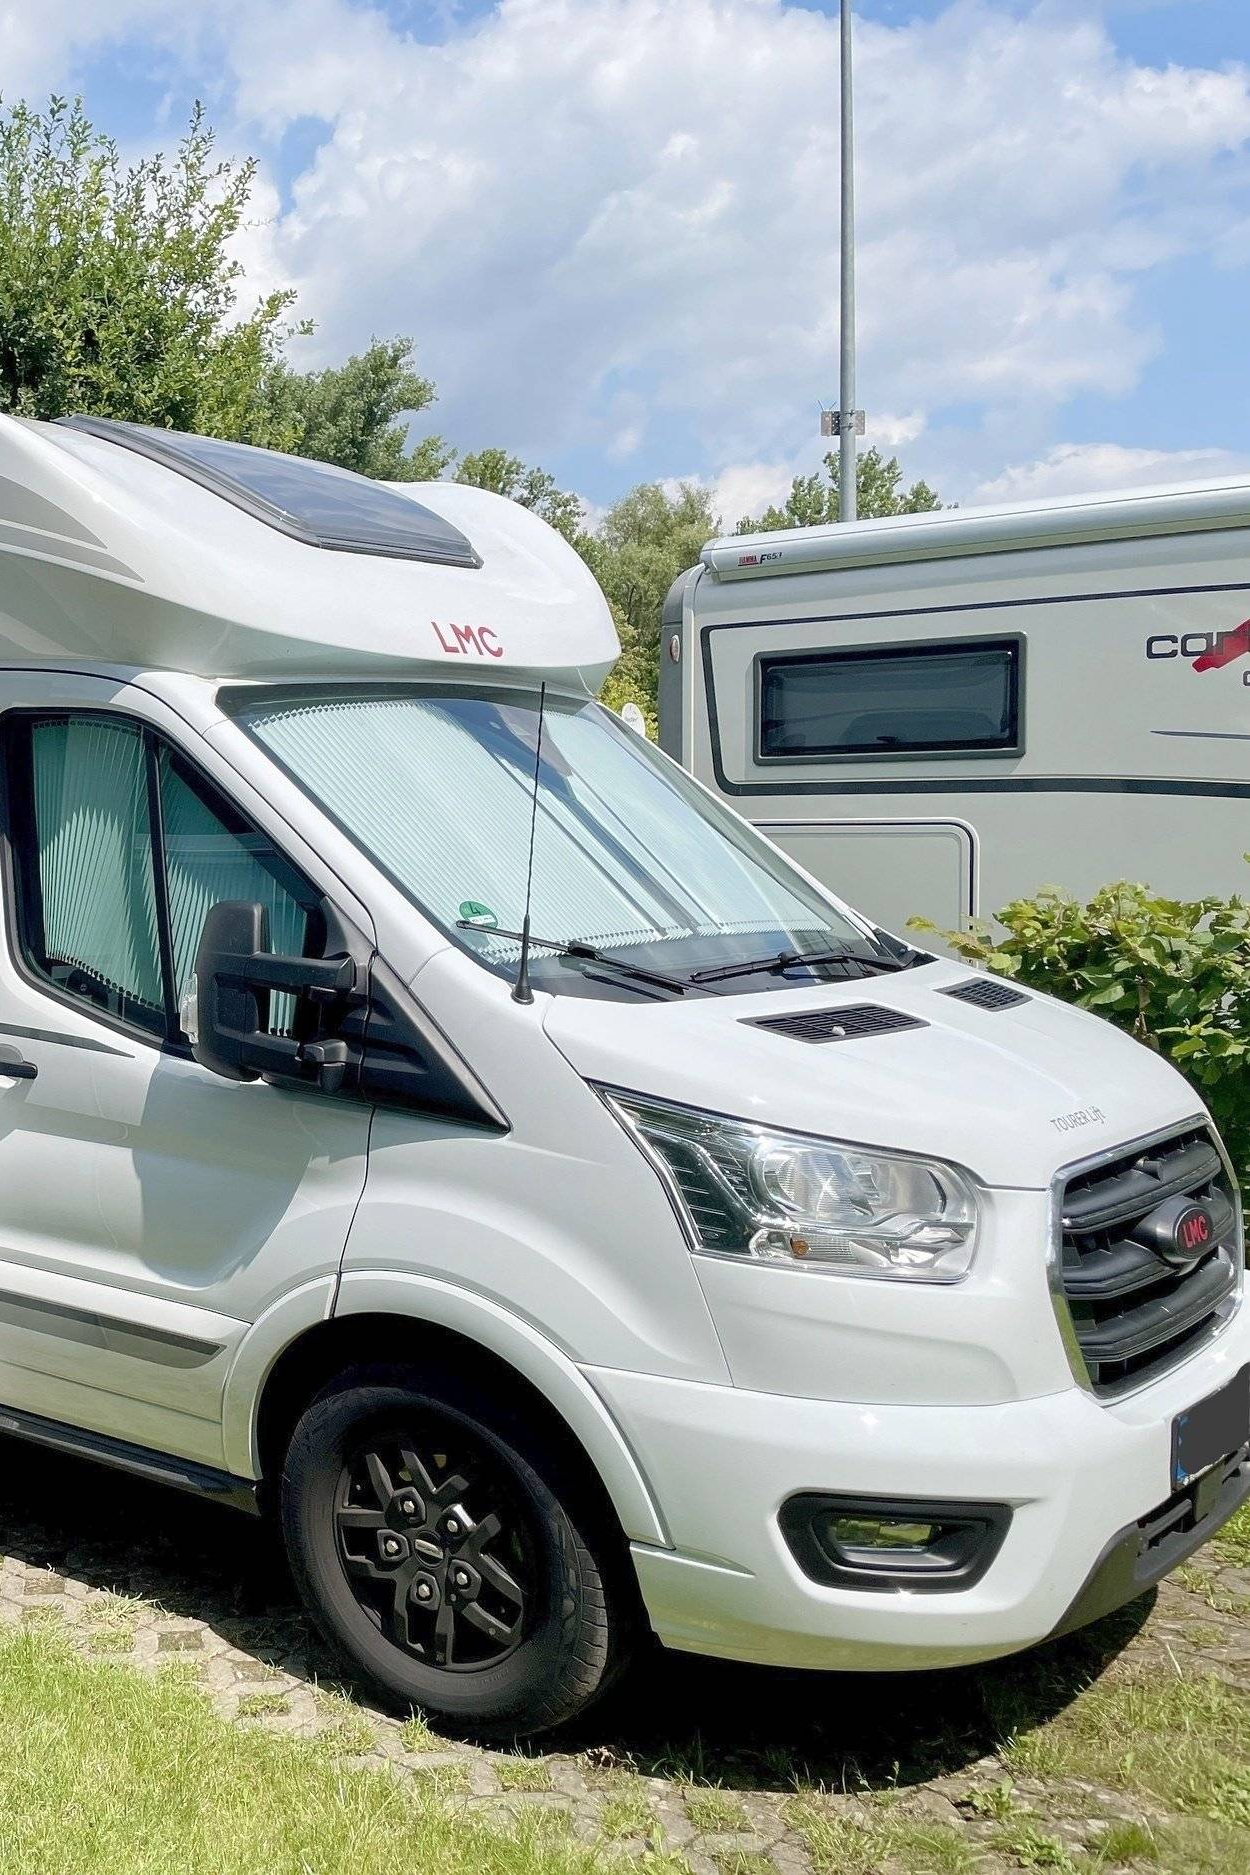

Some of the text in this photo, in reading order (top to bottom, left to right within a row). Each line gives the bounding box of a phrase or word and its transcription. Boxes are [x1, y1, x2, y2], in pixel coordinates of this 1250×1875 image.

[430, 621, 503, 657] LMC
[1050, 1111, 1090, 1132] TOURER
[1182, 1215, 1208, 1248] LMC
